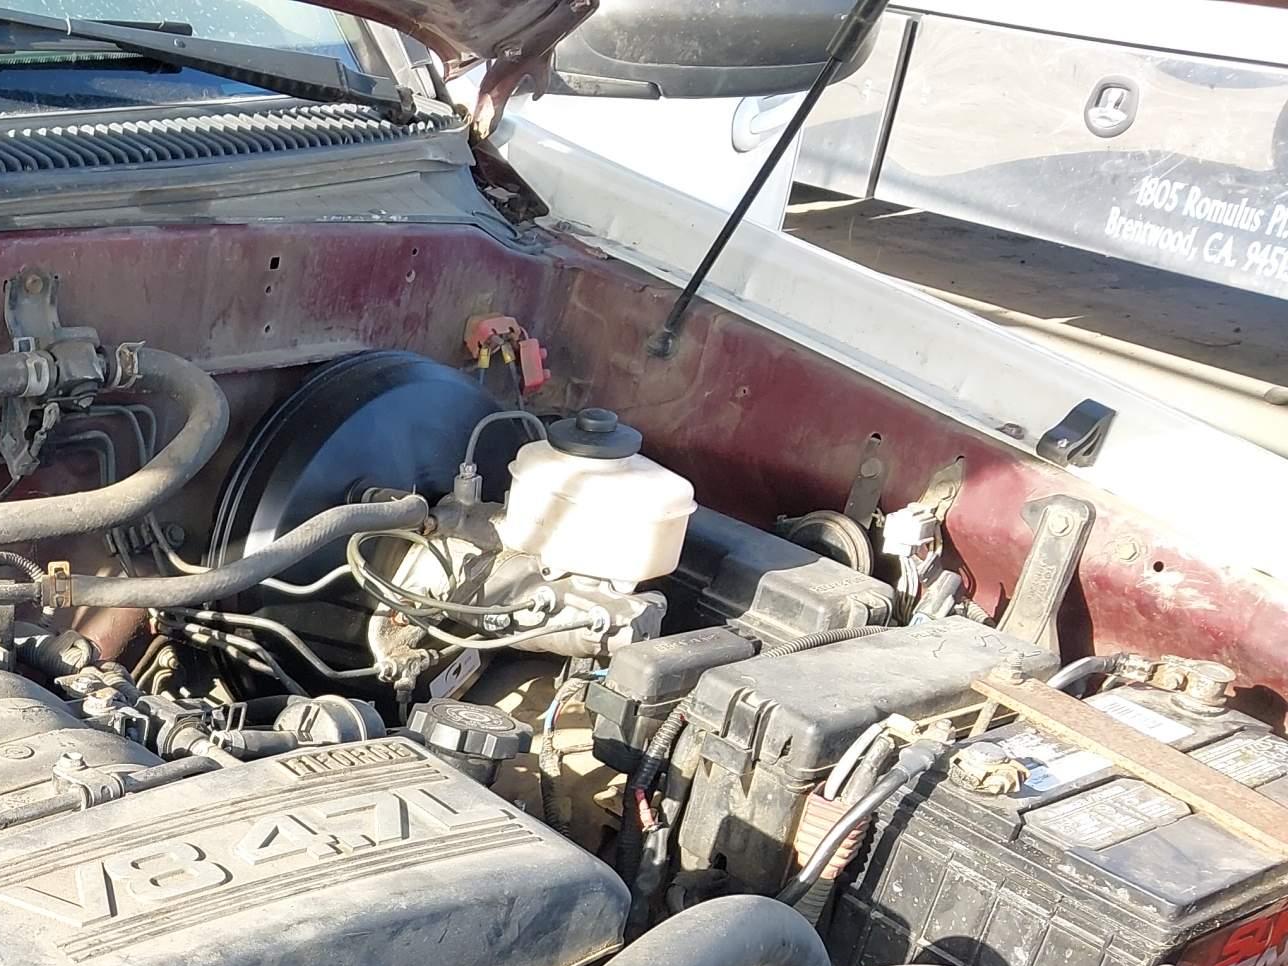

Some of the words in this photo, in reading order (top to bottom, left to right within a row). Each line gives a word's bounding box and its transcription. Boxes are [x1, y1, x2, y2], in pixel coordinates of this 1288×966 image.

[1135, 175, 1189, 211] 1805
[1182, 186, 1265, 232] Romulus
[1105, 206, 1199, 262] Brentwood,
